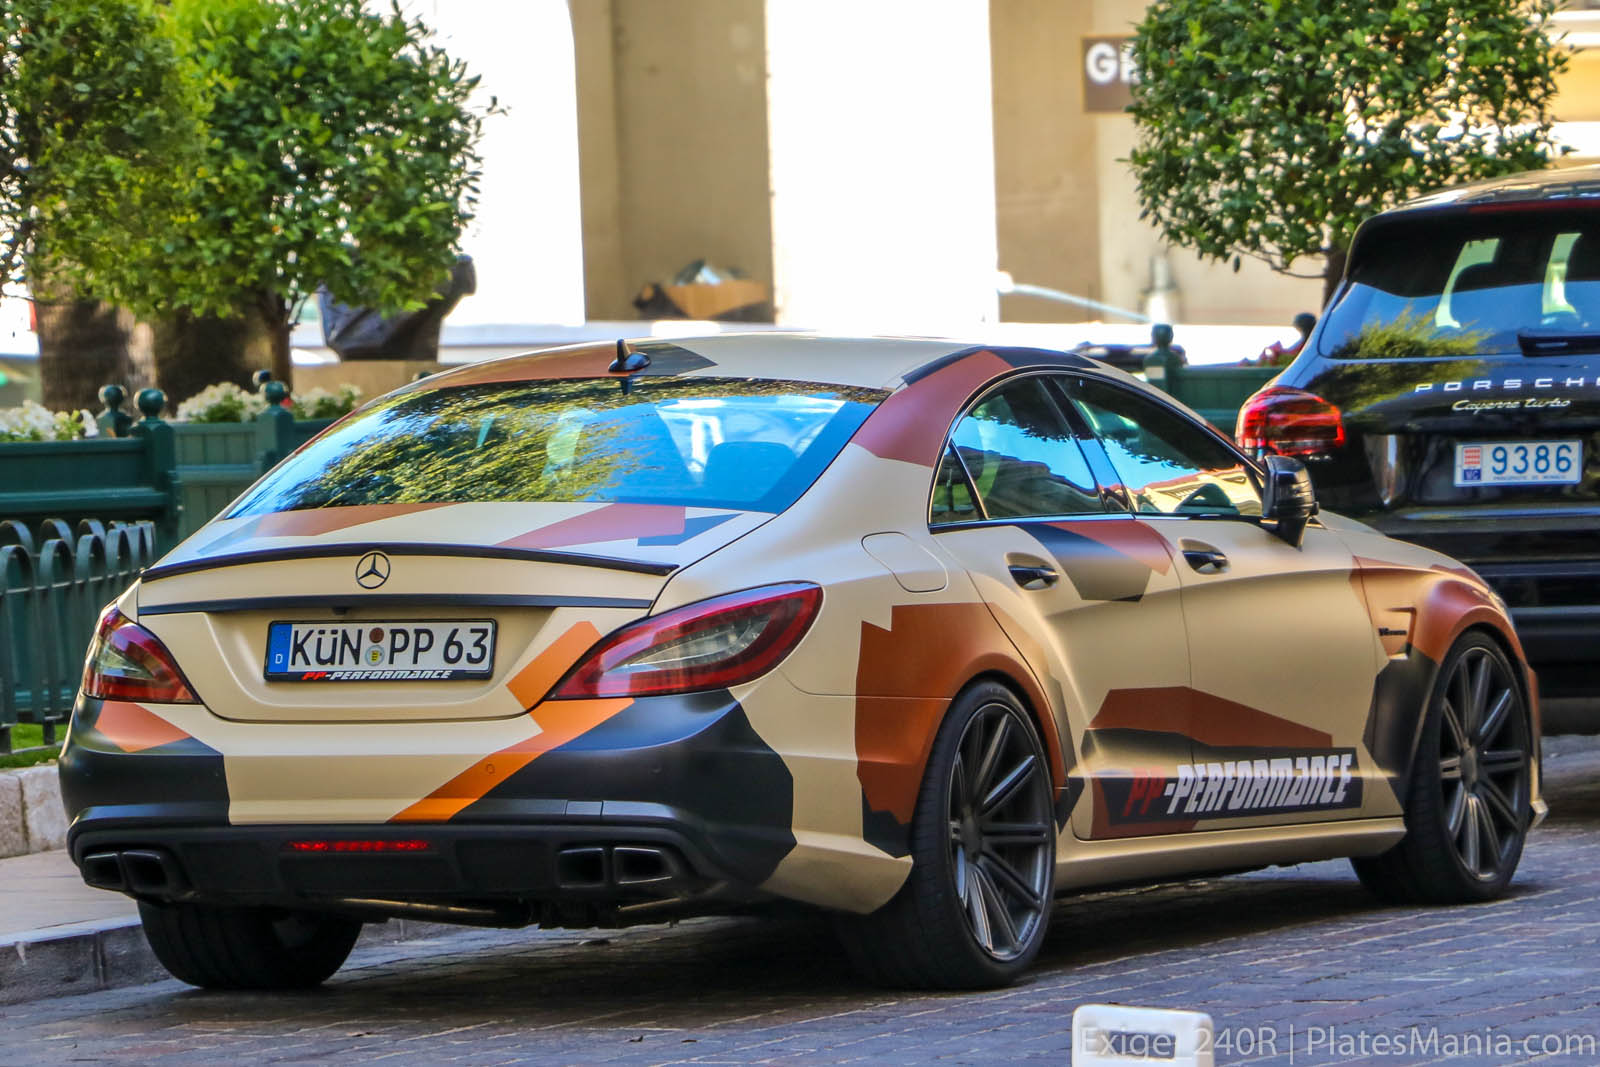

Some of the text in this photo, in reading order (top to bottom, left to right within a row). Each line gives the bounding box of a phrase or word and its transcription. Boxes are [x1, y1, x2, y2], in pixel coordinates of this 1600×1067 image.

[1415, 377, 1600, 393] PORSCH
[1452, 400, 1520, 414] Cayenne
[1492, 445, 1572, 475] 9386
[389, 628, 434, 665] PP
[443, 628, 489, 665] 63
[275, 653, 283, 664] D
[301, 670, 453, 680] PP-PERFORMANCE
[1122, 754, 1352, 817] PP-PERFORMANCE
